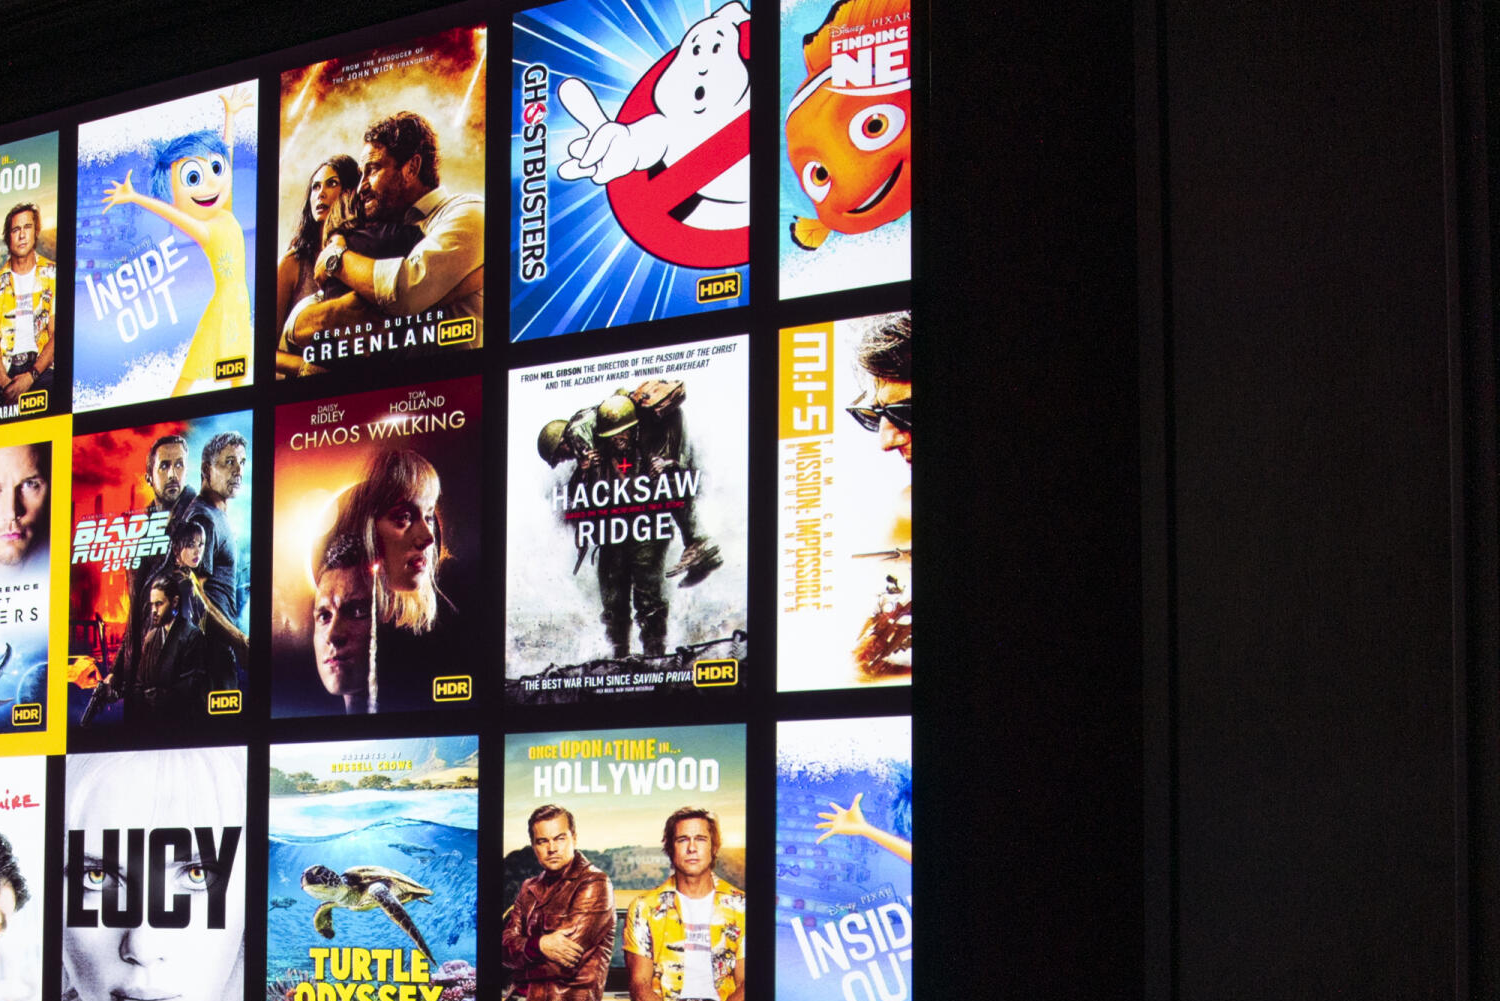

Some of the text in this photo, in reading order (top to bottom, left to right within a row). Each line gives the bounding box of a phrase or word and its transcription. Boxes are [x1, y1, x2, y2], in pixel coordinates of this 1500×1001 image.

[872, 11, 911, 28] PIXAR
[831, 26, 909, 55] FINDING
[347, 62, 394, 81] JOHN WICK
[831, 39, 909, 88] NE
[84, 234, 189, 321] INSIDE
[699, 277, 737, 299] HDR
[117, 275, 179, 343] OUT
[313, 310, 444, 341] GERARD BUTLER
[440, 322, 473, 340] HDR
[303, 325, 436, 364] GREENLAN
[216, 360, 244, 378] HDR
[520, 342, 738, 383] FROM MEL GIBSON THE DIRECTOR OF THE PASSION OF THE CHRIST
[545, 380, 559, 391] AND
[560, 378, 573, 388] THE
[573, 373, 605, 386] ACADEMY
[665, 358, 711, 374] BRAVEHEART
[20, 395, 45, 410] HDR
[317, 402, 339, 414] DAISY
[389, 395, 446, 415] HOLLAND
[408, 390, 427, 400] TOM
[289, 410, 467, 452] CHAOS WALKING
[310, 410, 345, 426] RIDLEY
[551, 469, 701, 511] HACKSAW
[795, 440, 822, 515] MISSION:
[73, 510, 172, 546] BLADE
[578, 512, 673, 548] RIDGE
[71, 535, 171, 565] RUNNER
[101, 557, 142, 573] 2049
[541, 671, 664, 690] BEST WAR FILM SINCE SAVING
[697, 665, 734, 681] HDR
[436, 681, 468, 697] HDR
[14, 707, 40, 722] HDR
[211, 696, 239, 710] HDR
[528, 738, 657, 761] ONCE UPON A TIME
[378, 759, 413, 772] CROWE
[533, 756, 720, 798] HOLLYWOOD
[66, 826, 242, 930] LUCY
[790, 896, 912, 980] INSID
[309, 947, 430, 983] TURTLE
